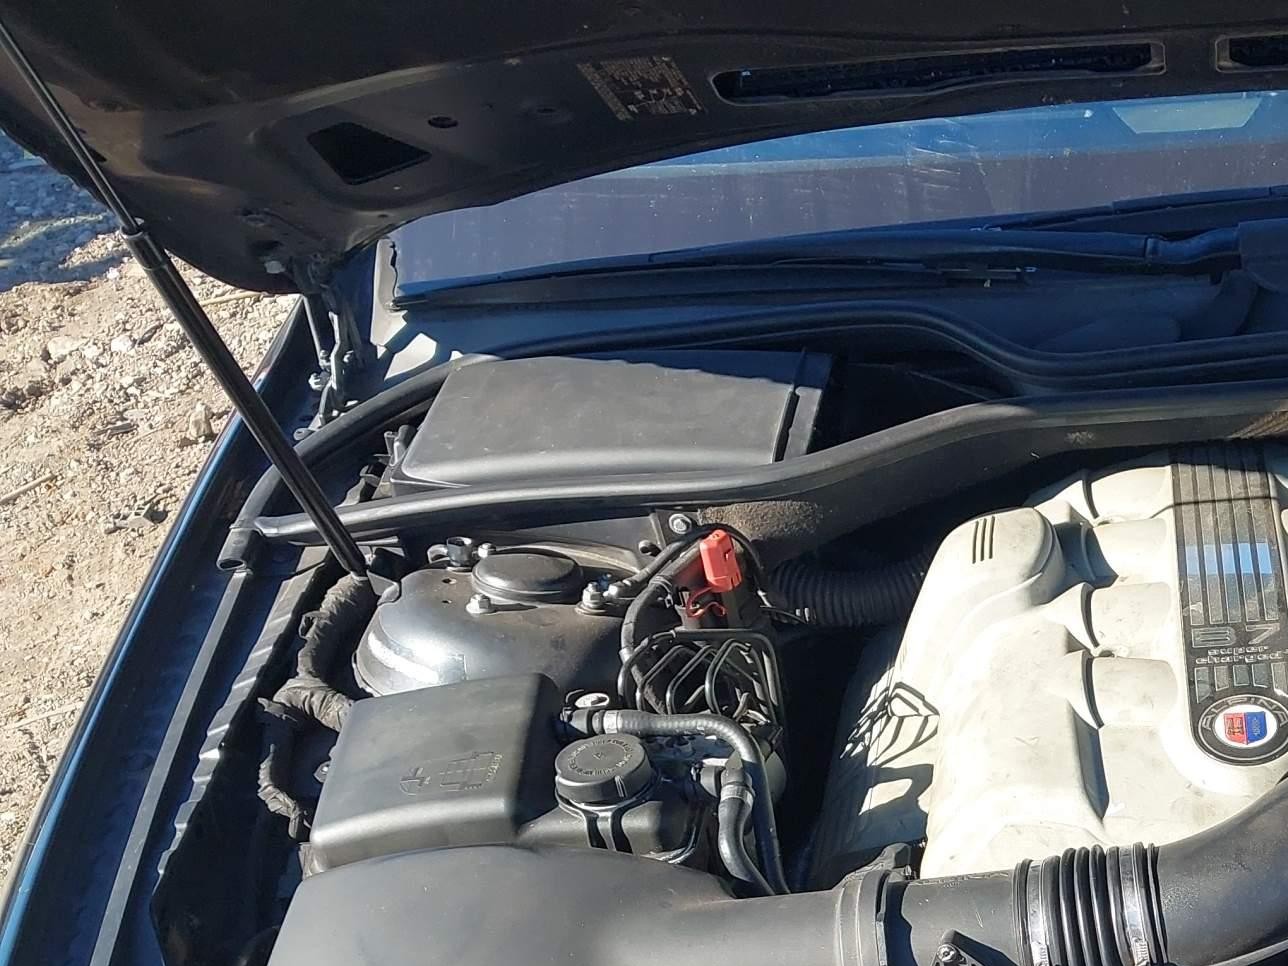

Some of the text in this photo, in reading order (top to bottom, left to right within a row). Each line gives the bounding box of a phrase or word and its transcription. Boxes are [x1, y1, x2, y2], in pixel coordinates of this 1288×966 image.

[1196, 650, 1284, 664] charged
[1208, 646, 1269, 655] super
[1202, 697, 1288, 731] ALPINA
